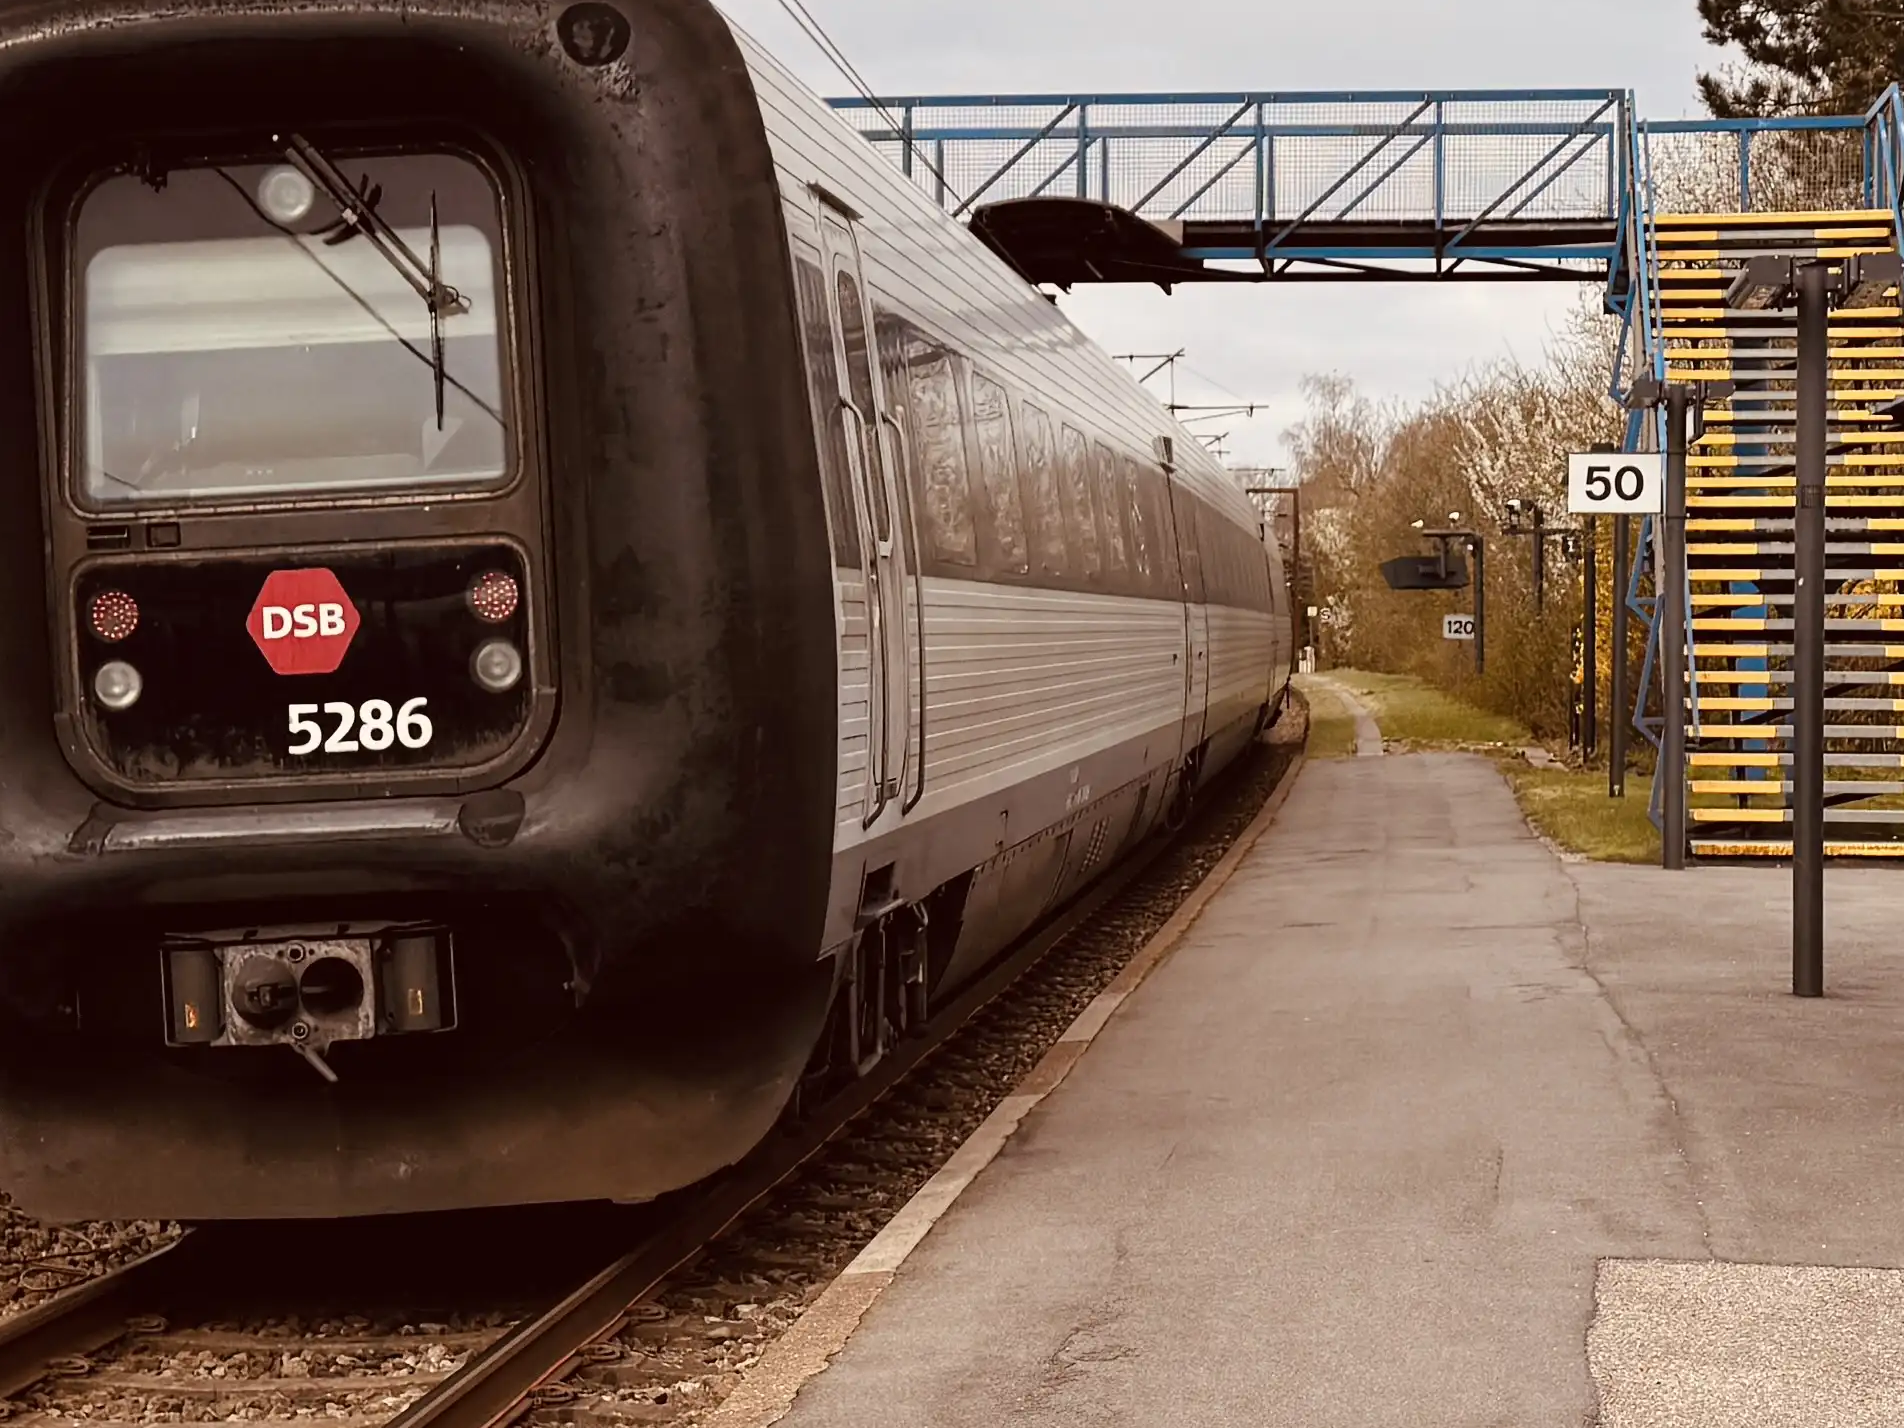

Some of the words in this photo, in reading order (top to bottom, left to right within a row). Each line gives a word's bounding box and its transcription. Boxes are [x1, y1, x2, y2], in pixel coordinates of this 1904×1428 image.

[1585, 465, 1644, 501] 50
[262, 602, 346, 639] DSB
[1447, 620, 1474, 635] 120
[288, 696, 433, 755] 5286
